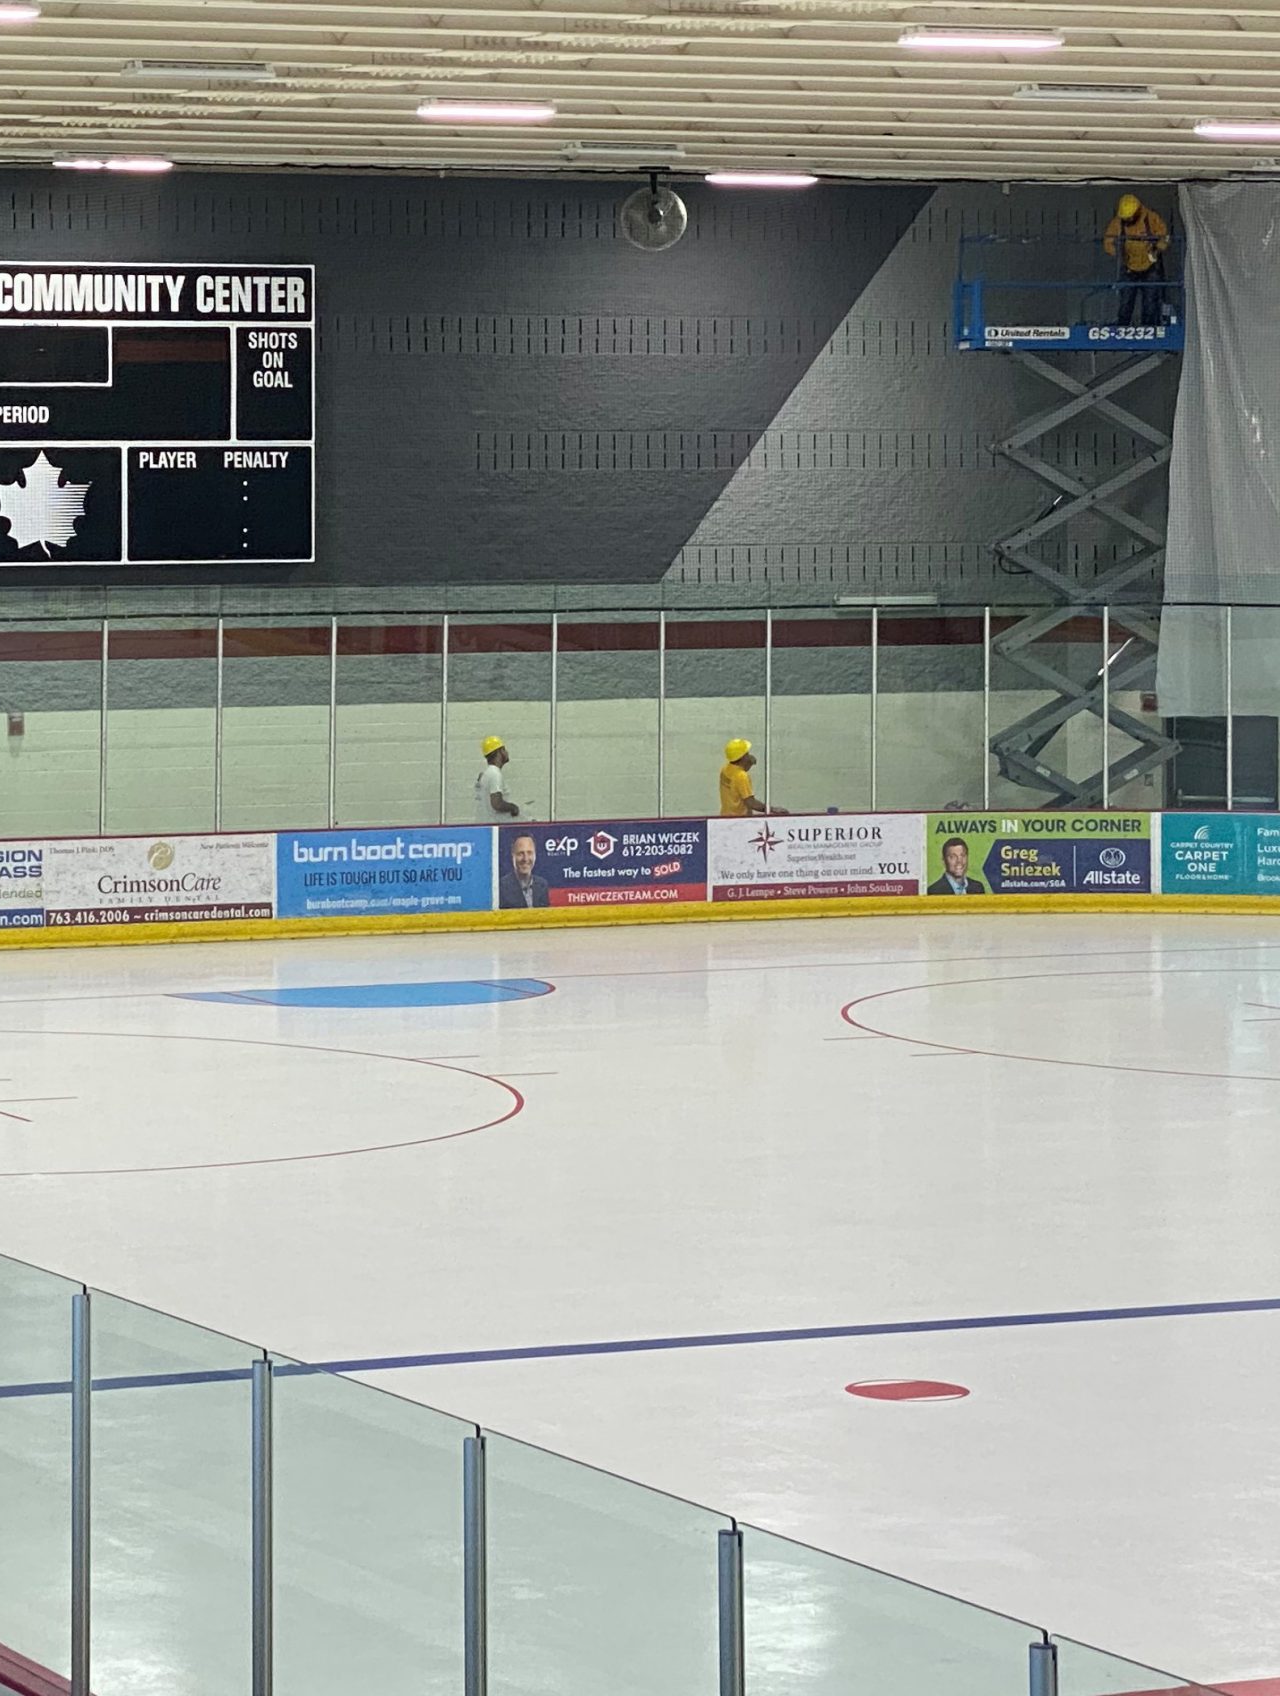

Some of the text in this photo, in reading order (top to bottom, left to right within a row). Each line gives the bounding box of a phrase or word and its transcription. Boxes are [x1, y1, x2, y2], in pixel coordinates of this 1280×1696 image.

[196, 275, 306, 314] CENTER
[248, 331, 298, 350] SHOTS
[1001, 328, 1031, 337] United
[1088, 326, 1155, 341] GS-3232
[262, 351, 283, 369] ON
[252, 370, 293, 388] GOAL
[138, 451, 288, 469] PLAYER PENALTY
[935, 818, 1142, 834] ALWAYS IN YOUR CORNER
[622, 831, 700, 846] BRIAN WICZEK
[787, 827, 882, 842] SUPERIOR
[293, 837, 473, 864] burn boot camp
[622, 844, 693, 857] 612-203-5082
[1000, 845, 1039, 862] Greg
[1175, 850, 1229, 861] CARPET
[563, 862, 681, 879] The fastest way to SOLD
[720, 870, 735, 880] We
[736, 870, 754, 880] only
[756, 868, 777, 879] have
[778, 869, 794, 878] one
[795, 868, 819, 879] thing
[820, 869, 832, 877] on
[833, 868, 848, 877] our
[878, 862, 910, 875] YOU.
[1000, 862, 1061, 877] Sniezek
[1187, 862, 1217, 872] ONE
[97, 872, 222, 895] CrimsonCare
[304, 867, 463, 887] LIFE IS TOUGH BUT SO ARE YOU
[1082, 870, 1141, 886] Allstate
[568, 889, 679, 903] THEWICZEKTEAM.COM
[783, 886, 807, 896] Steve
[808, 885, 838, 895] Powers
[847, 884, 867, 895] John
[869, 883, 904, 895] Soukup
[49, 909, 130, 925] 763.416.2006
[144, 905, 270, 921] crimsoncaredental.com
